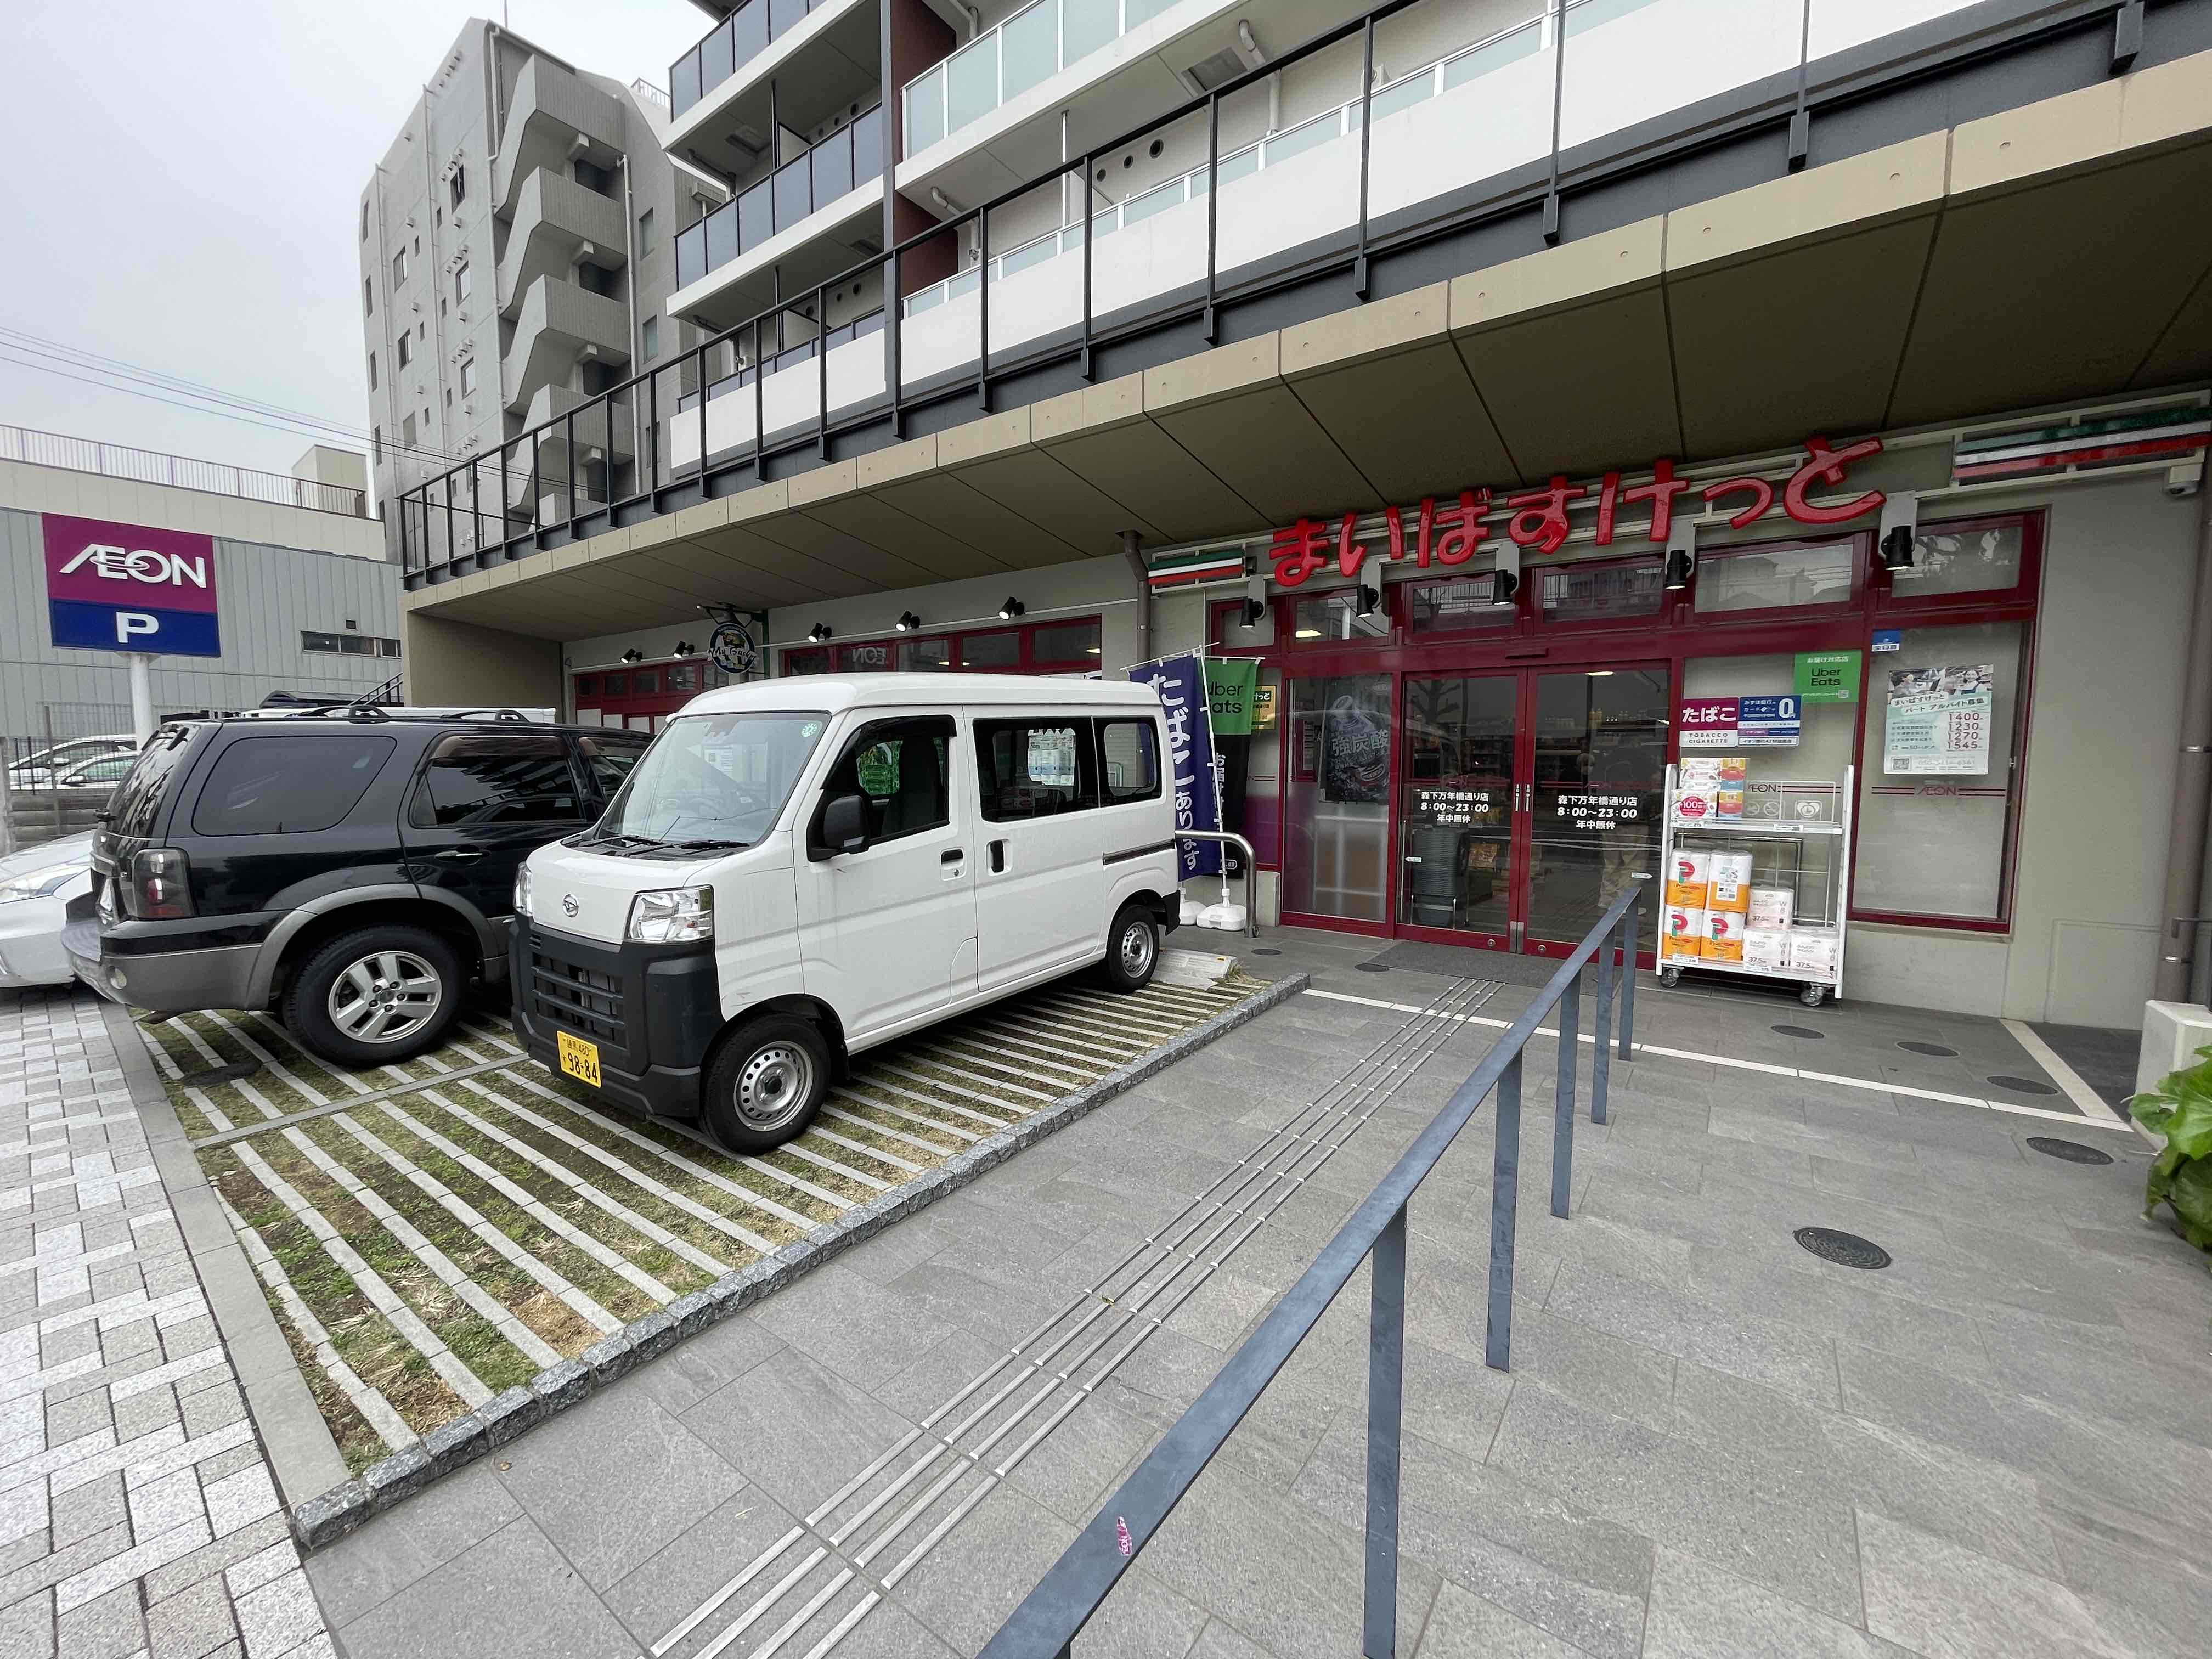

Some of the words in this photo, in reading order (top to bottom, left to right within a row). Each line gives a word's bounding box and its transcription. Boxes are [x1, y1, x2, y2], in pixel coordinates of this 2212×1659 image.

[1270, 437, 1887, 587] まいばすけっと
[116, 612, 159, 644] P
[1812, 668, 1841, 676] Uber
[1810, 678, 1841, 686] Eats
[1682, 706, 1736, 723] たばこ
[1949, 713, 1980, 721] 1400
[1948, 723, 1979, 731] 1230
[1948, 732, 1978, 740] 1270
[1331, 729, 1391, 756] 強炭酸
[1948, 741, 1978, 749] 1545
[1421, 791, 1489, 801] 森下万年橋通り店
[1558, 795, 1638, 806] 森下万年橋通り店
[1437, 814, 1471, 823] 年中無休
[1576, 820, 1616, 830] 年中無休
